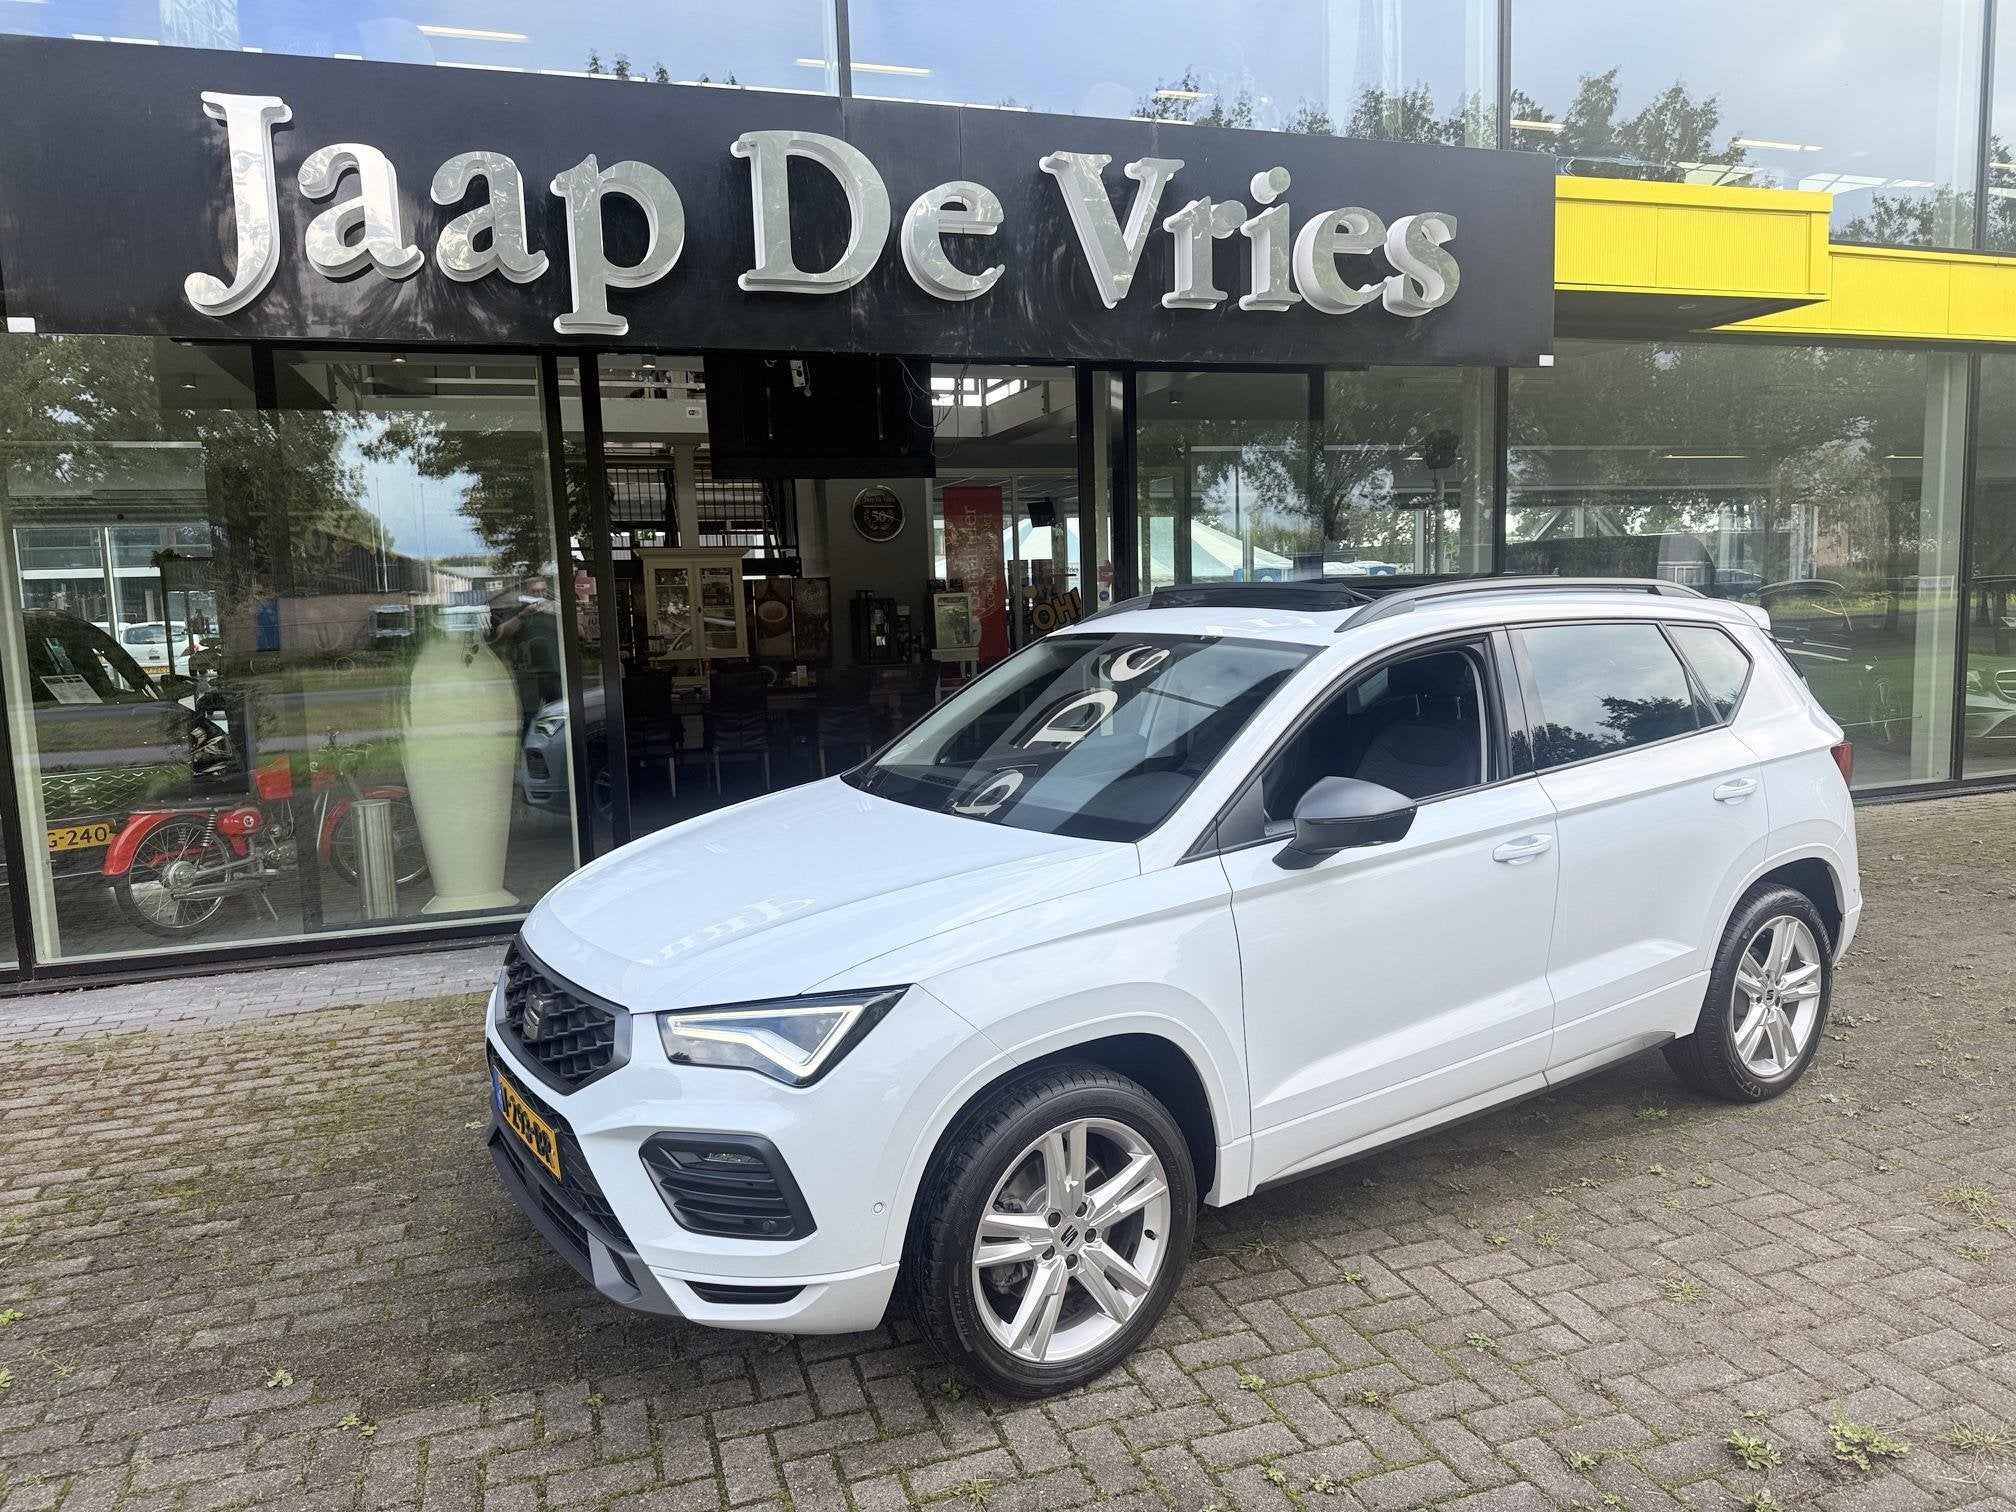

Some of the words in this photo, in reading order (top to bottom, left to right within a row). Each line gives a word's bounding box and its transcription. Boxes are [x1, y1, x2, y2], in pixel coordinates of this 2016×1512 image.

[184, 91, 686, 336] Jaap
[730, 130, 1006, 302] De
[1039, 151, 1460, 317] Vries
